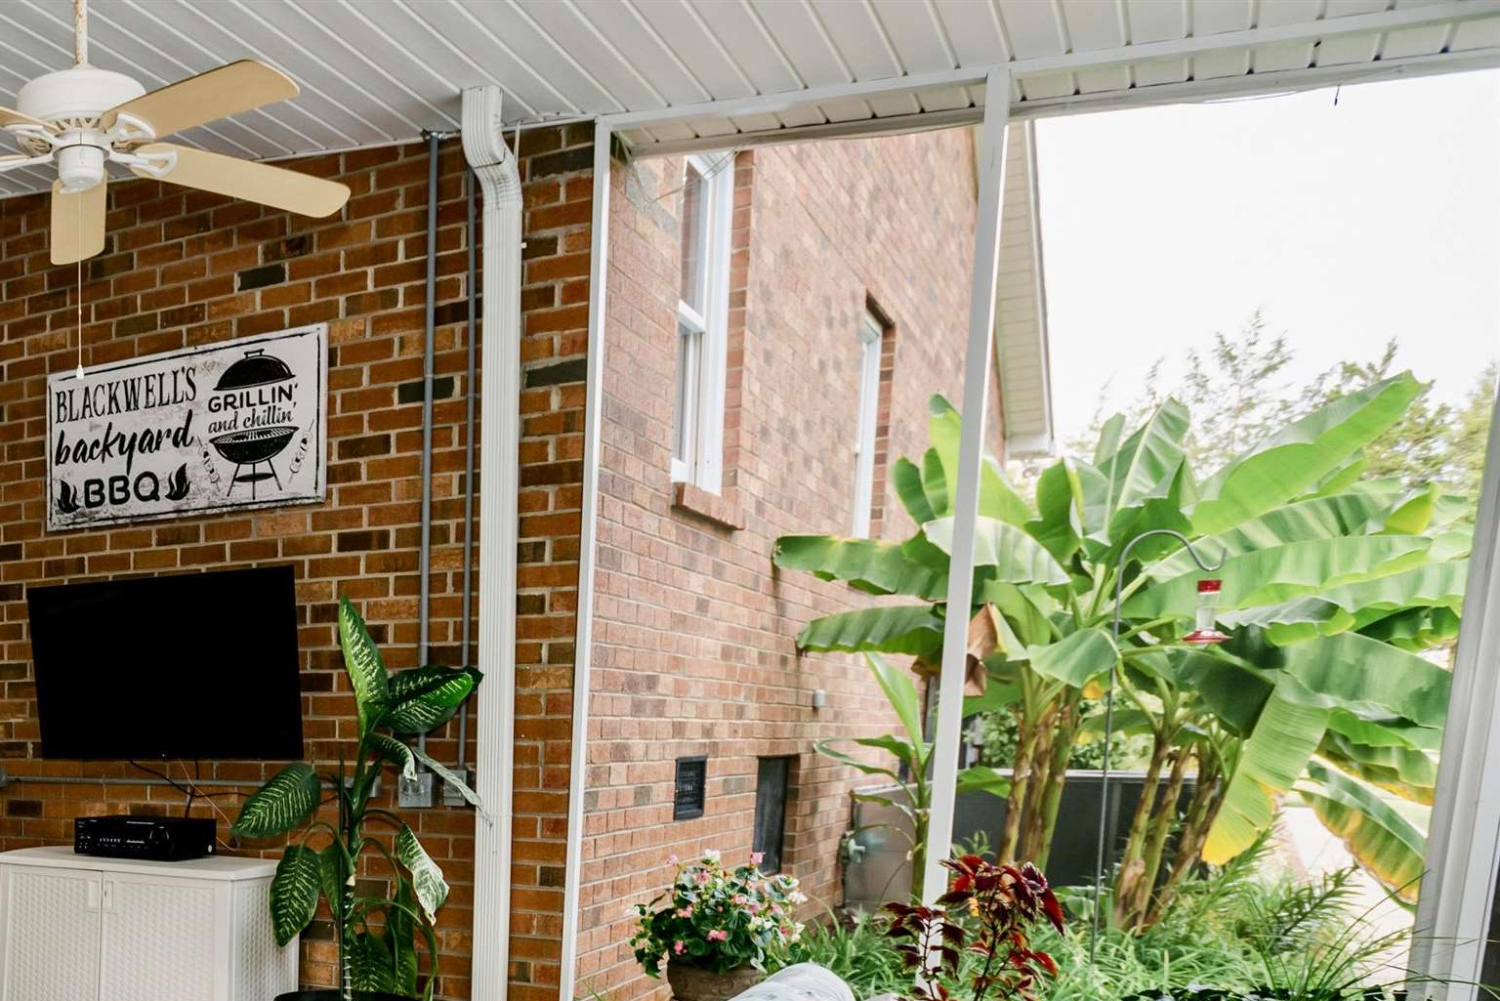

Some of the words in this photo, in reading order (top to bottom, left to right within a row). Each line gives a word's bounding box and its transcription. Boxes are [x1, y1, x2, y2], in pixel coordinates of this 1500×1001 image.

[56, 366, 197, 424] BLACKWELL'S
[208, 383, 298, 413] GRILLIN'
[208, 411, 239, 434] and
[55, 409, 194, 476] backyard
[84, 471, 160, 509] BBQ
